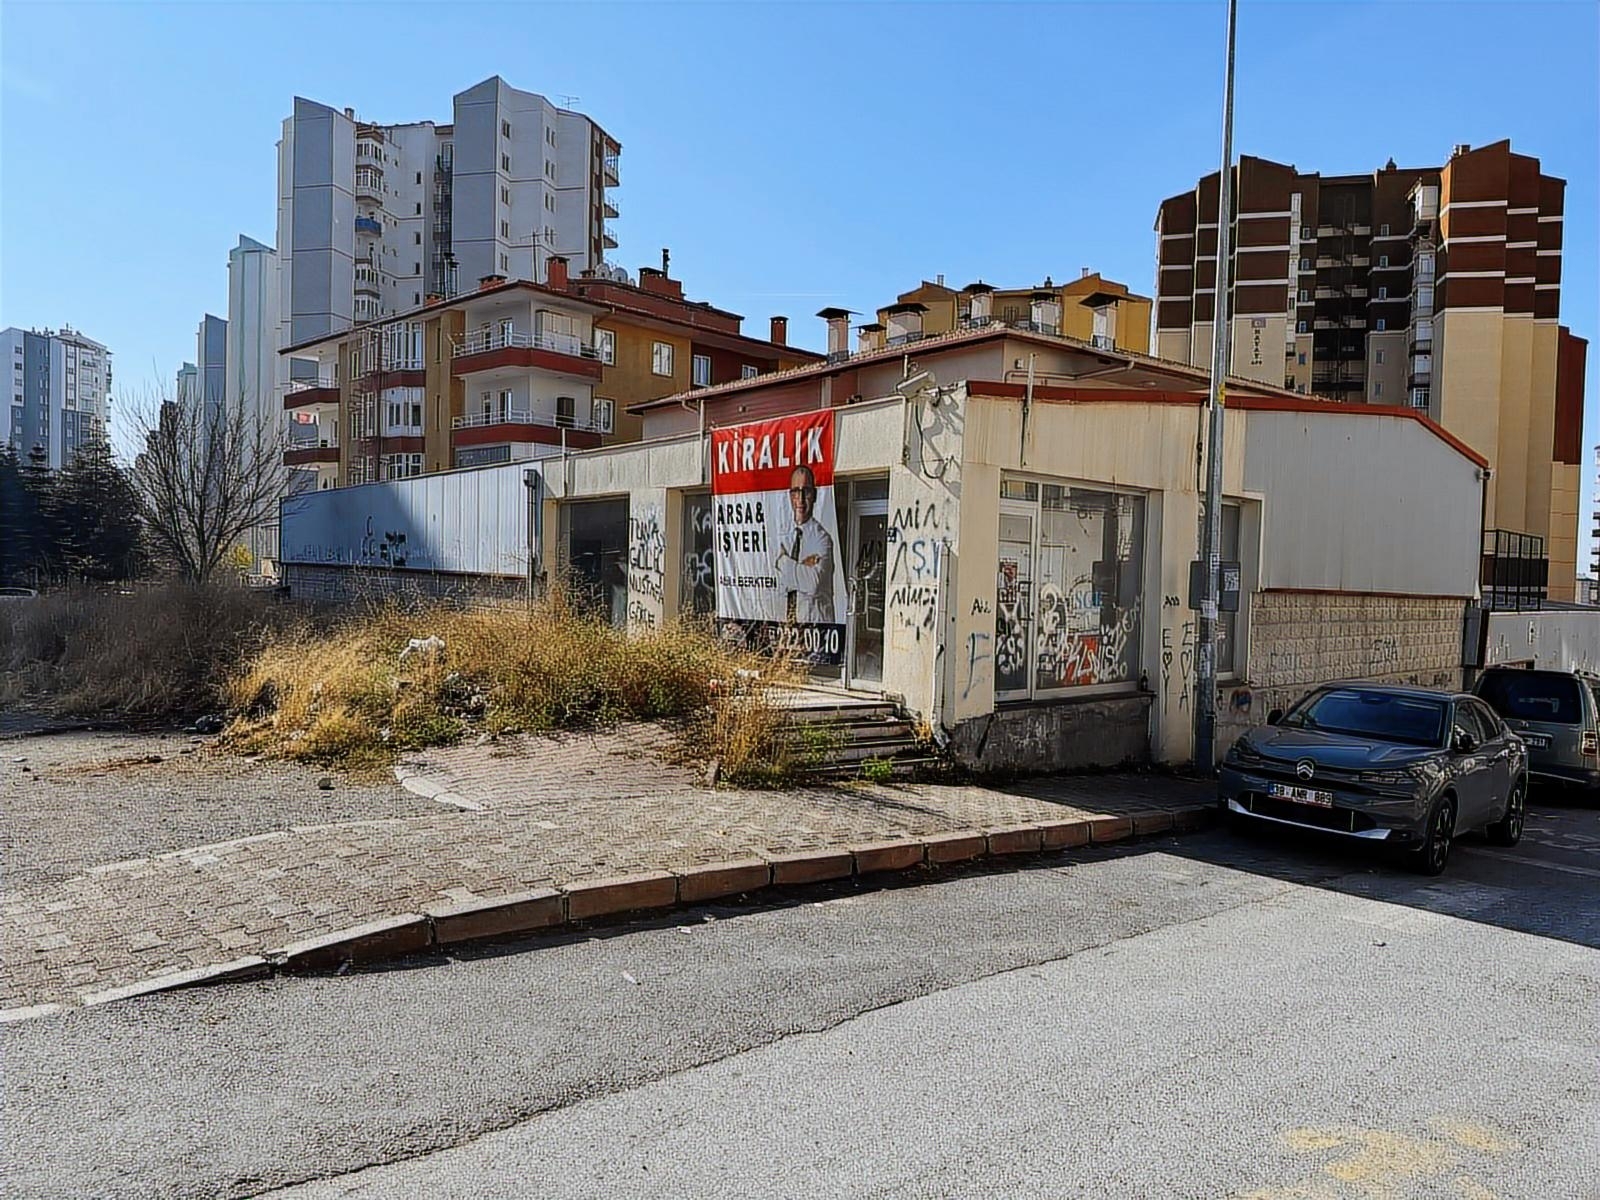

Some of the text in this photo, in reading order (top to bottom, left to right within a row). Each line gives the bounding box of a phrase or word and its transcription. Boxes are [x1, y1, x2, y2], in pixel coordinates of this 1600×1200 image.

[717, 426, 824, 475] KİRALIK
[717, 526, 767, 557] İŞYERİ
[824, 628, 839, 654] 10
